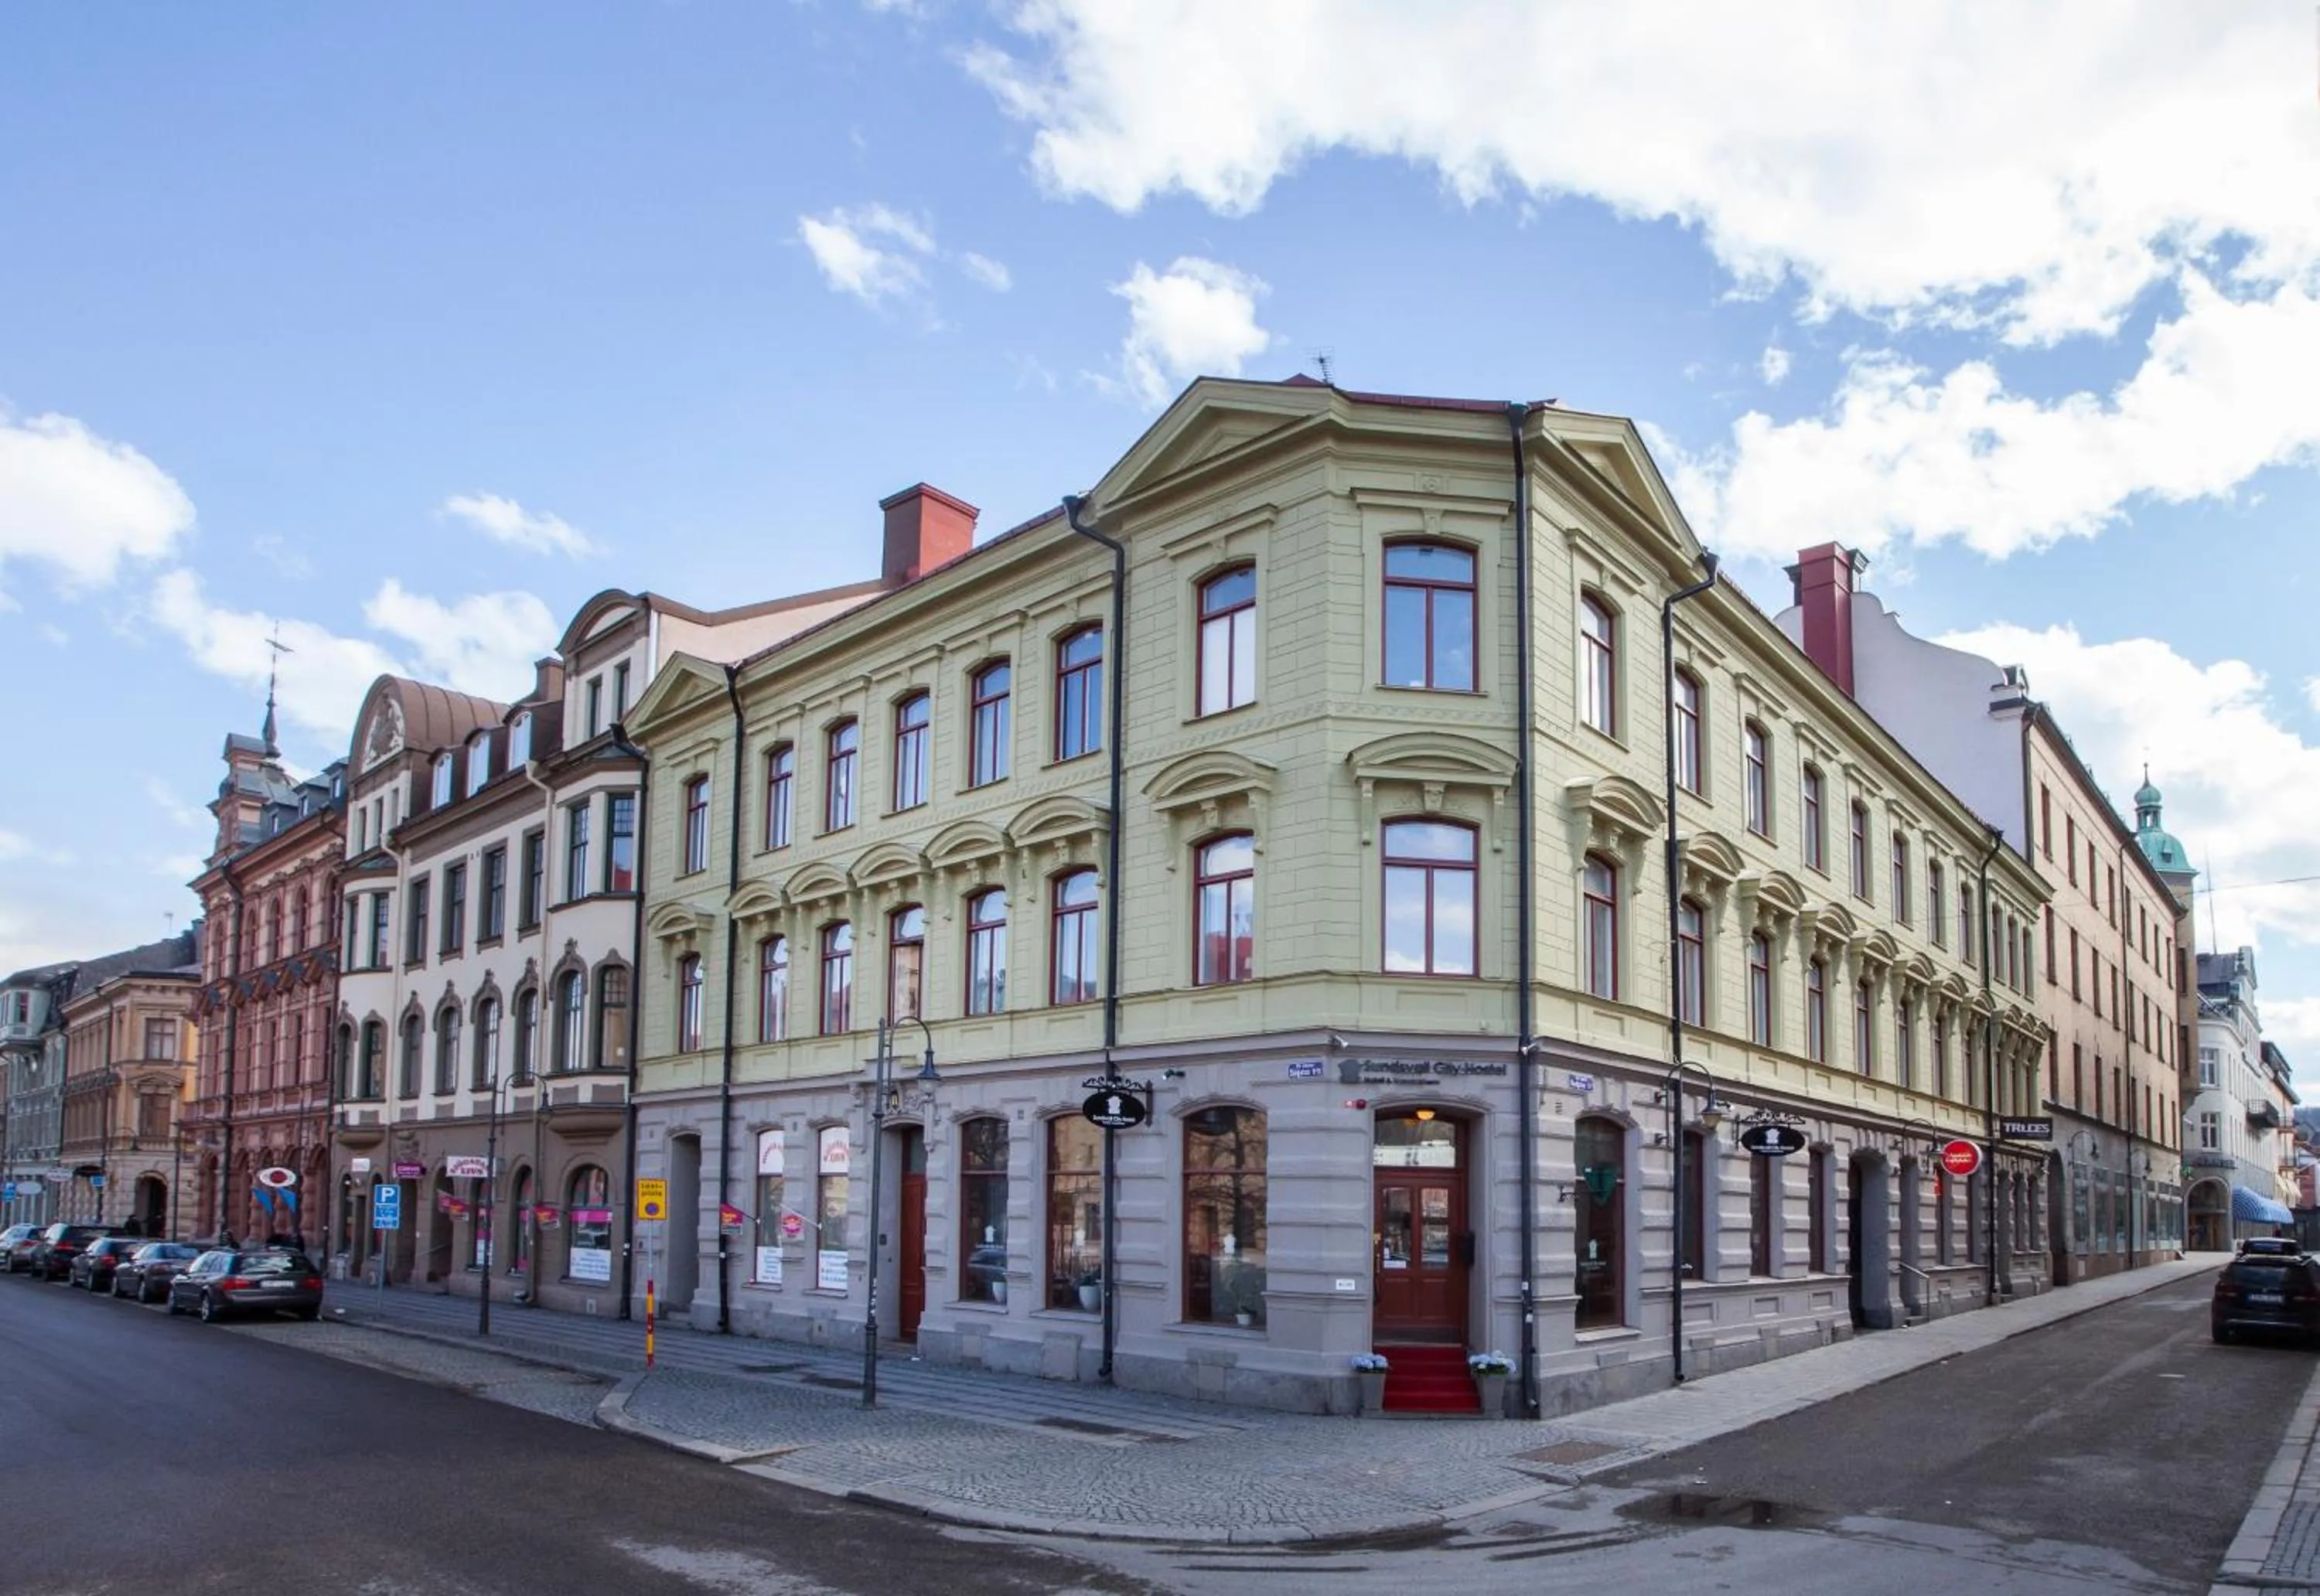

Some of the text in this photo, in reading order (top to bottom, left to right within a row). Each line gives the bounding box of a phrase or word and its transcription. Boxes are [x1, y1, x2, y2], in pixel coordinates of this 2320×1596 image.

[1363, 1059, 1506, 1076] Sundsvall City Hostel
[381, 1187, 395, 1202] P
